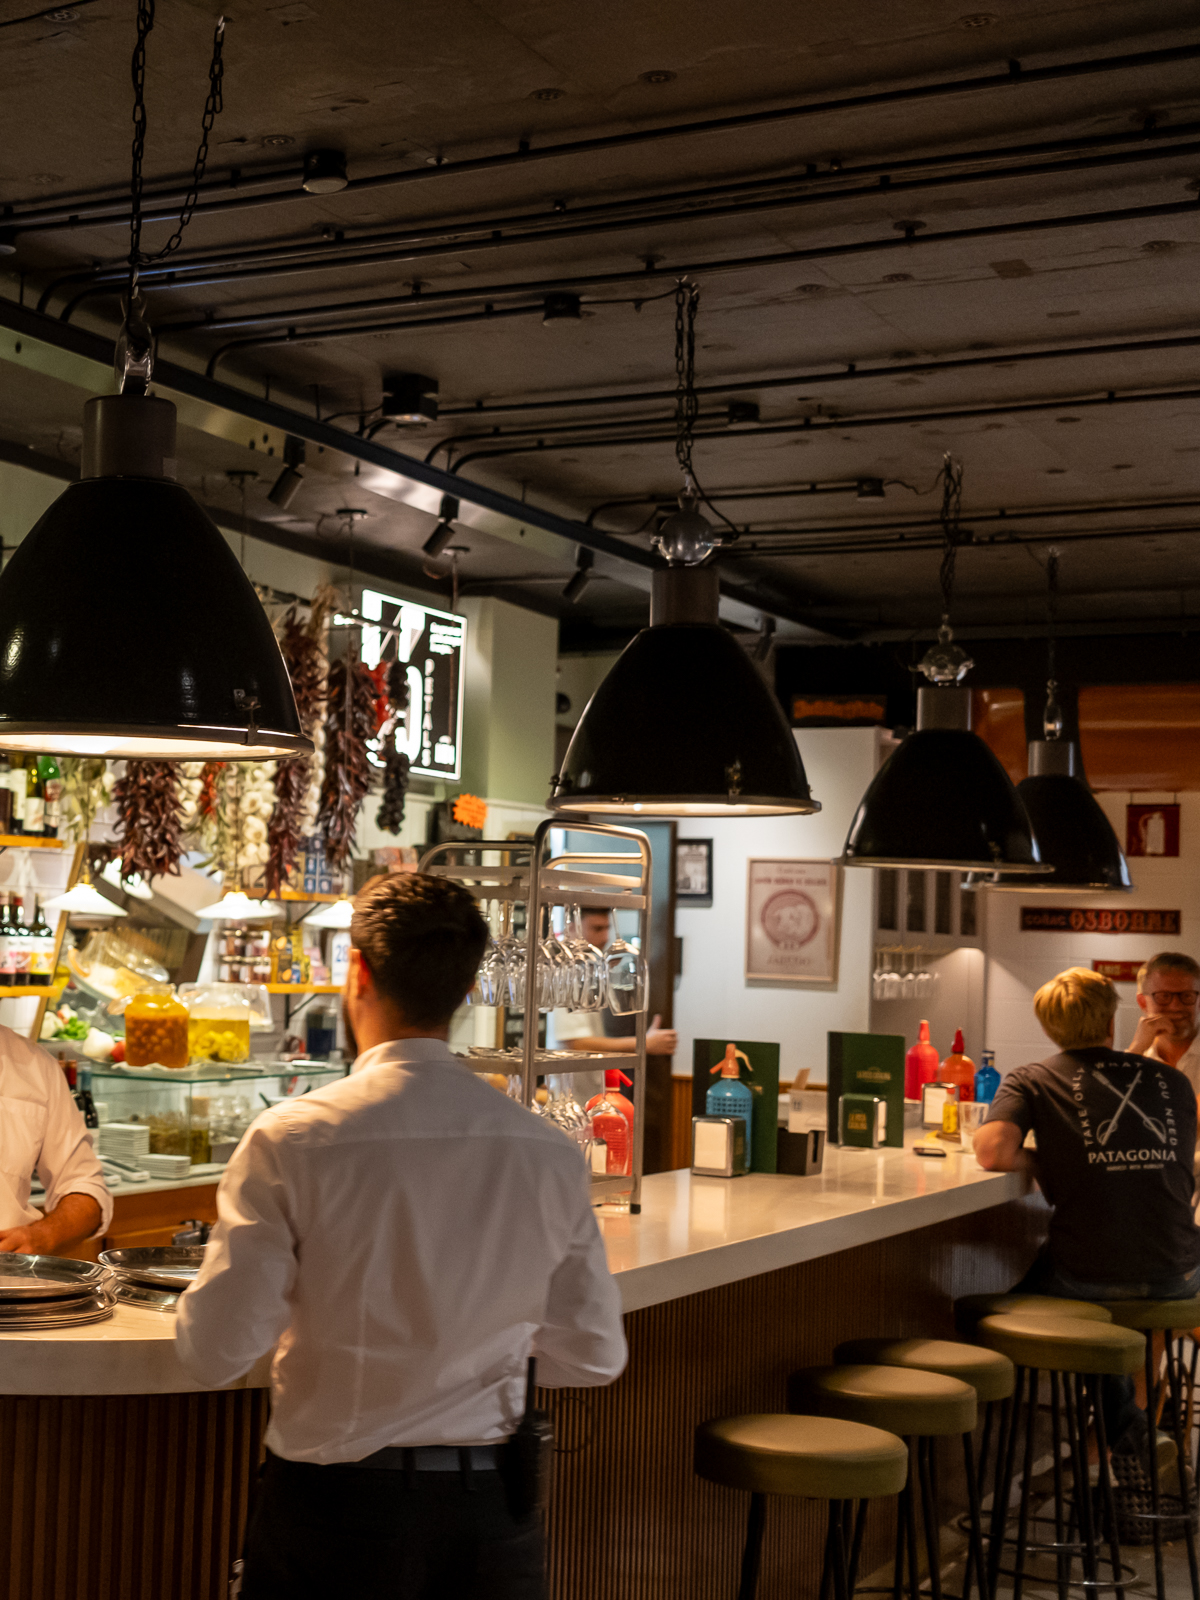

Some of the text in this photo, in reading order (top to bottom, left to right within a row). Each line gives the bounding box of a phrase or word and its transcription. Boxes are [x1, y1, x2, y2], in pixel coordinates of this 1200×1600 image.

[1072, 1067, 1085, 1102] ONLY
[1078, 1109, 1094, 1147] TAKE
[1165, 1108, 1178, 1146] NEED
[1088, 1148, 1177, 1164] PATAGONIA
